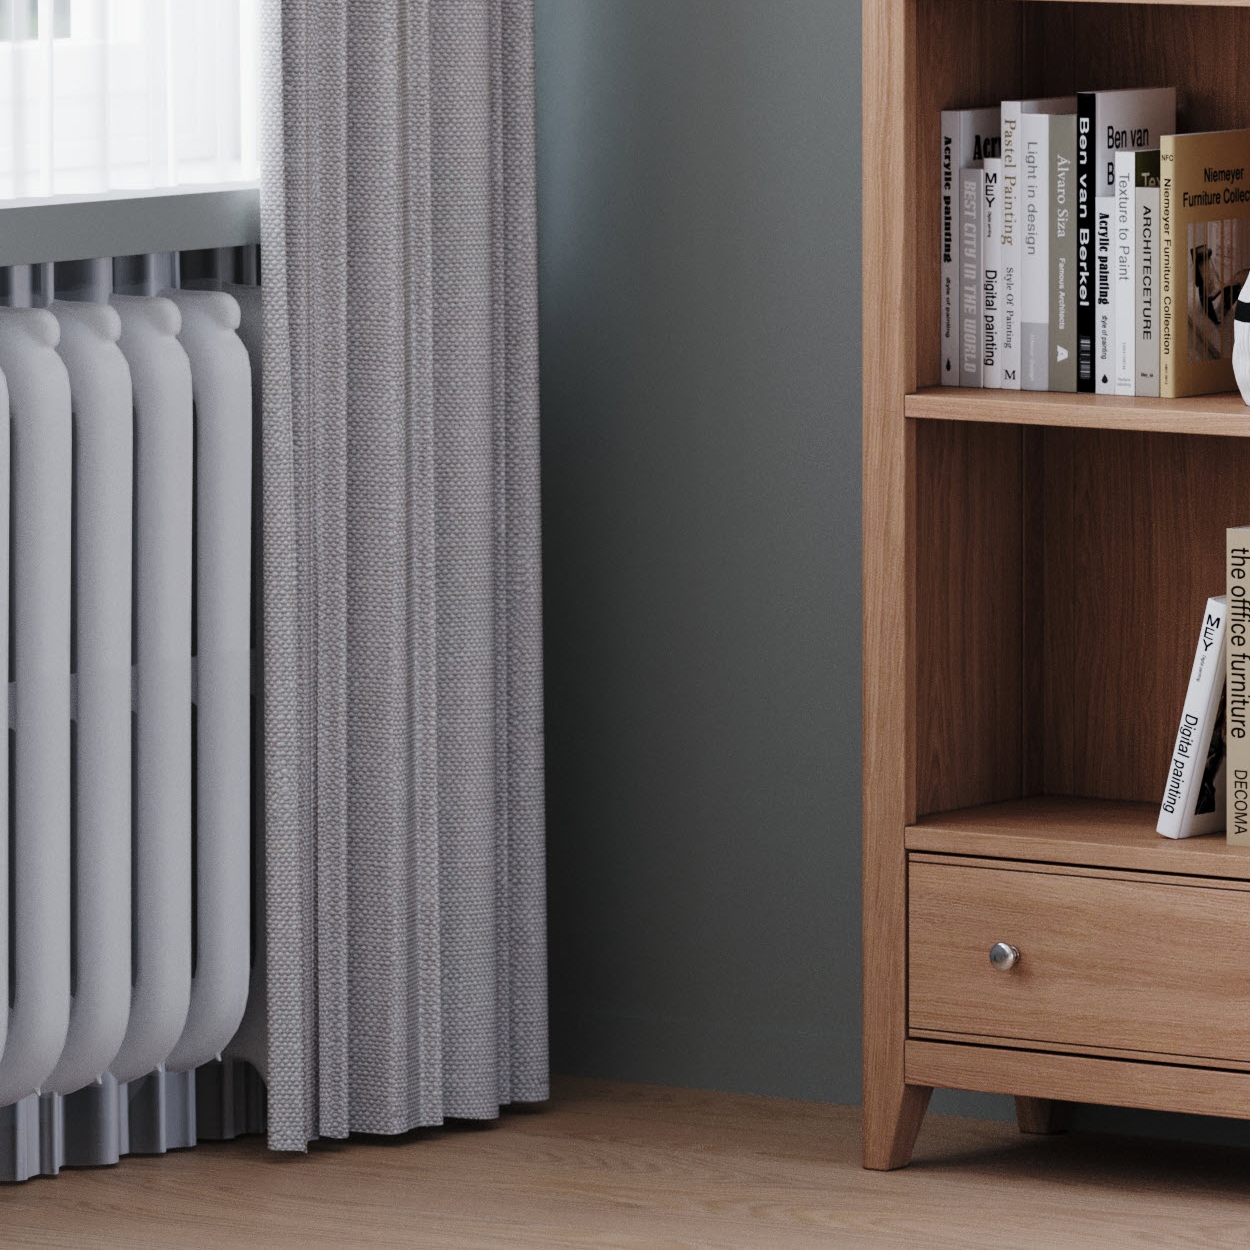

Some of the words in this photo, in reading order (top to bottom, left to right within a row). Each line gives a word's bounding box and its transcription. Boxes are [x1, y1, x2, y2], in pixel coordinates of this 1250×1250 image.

[1004, 119, 1017, 168] Pastel
[1079, 117, 1090, 165] Ben
[1107, 125, 1127, 149] Ben
[1130, 128, 1149, 147] van
[943, 136, 952, 191] Acrylic
[1025, 141, 1038, 179] Light
[1161, 154, 1174, 162] NFC
[1203, 167, 1245, 184] Niemeyer
[964, 180, 977, 217] BEST
[1027, 185, 1038, 198] in
[1057, 154, 1070, 204] Álvaro
[1079, 173, 1088, 218] van
[1119, 173, 1130, 223] Texture
[1183, 190, 1221, 208] Furniture
[1001, 176, 1017, 246] Painting
[1057, 209, 1069, 238] Siza
[1163, 178, 1171, 235] Niemeyer
[943, 195, 952, 263] painting
[1025, 203, 1038, 255] design
[1098, 212, 1109, 252] Acrylic
[1119, 228, 1129, 241] to
[1004, 267, 1014, 291] Style
[1058, 257, 1066, 289] Famous
[1079, 228, 1090, 307] Berkel
[1098, 255, 1109, 305] painting
[1119, 245, 1130, 281] Paint
[1142, 205, 1152, 341] ARCHITECETURE
[1163, 239, 1172, 292] Furniture
[964, 285, 977, 315] THE
[984, 270, 997, 311] Digital
[1006, 293, 1014, 306] Of
[1058, 291, 1066, 330] Architects
[964, 318, 977, 373] WORLD
[984, 315, 997, 367] painting
[1004, 310, 1014, 349] Painting
[1101, 329, 1108, 337] of
[1163, 296, 1172, 355] Collection
[1100, 336, 1108, 360] painting
[1004, 369, 1016, 380] M
[1231, 547, 1250, 580] the
[1178, 713, 1199, 758] Digital
[1162, 758, 1185, 814] painting
[1234, 769, 1248, 835] DECOMA
